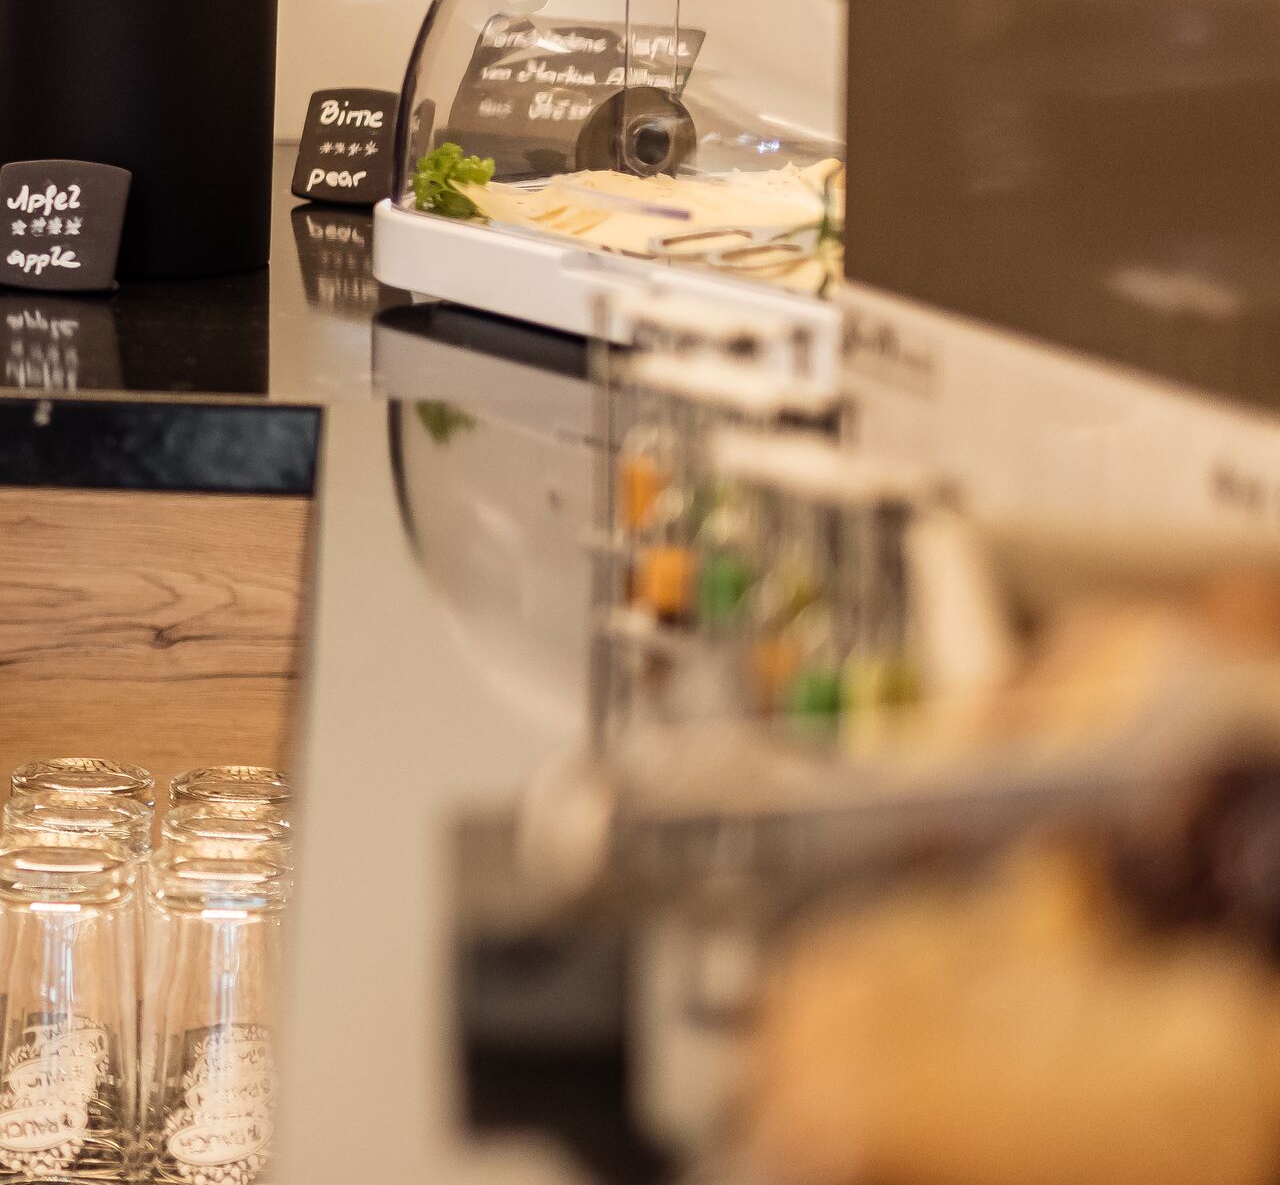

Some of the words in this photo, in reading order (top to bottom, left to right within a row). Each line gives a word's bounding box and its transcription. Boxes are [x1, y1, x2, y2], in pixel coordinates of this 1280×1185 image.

[319, 99, 384, 129] Birne
[306, 167, 367, 192] pear
[6, 184, 81, 216] Apfel
[6, 245, 82, 275] apple
